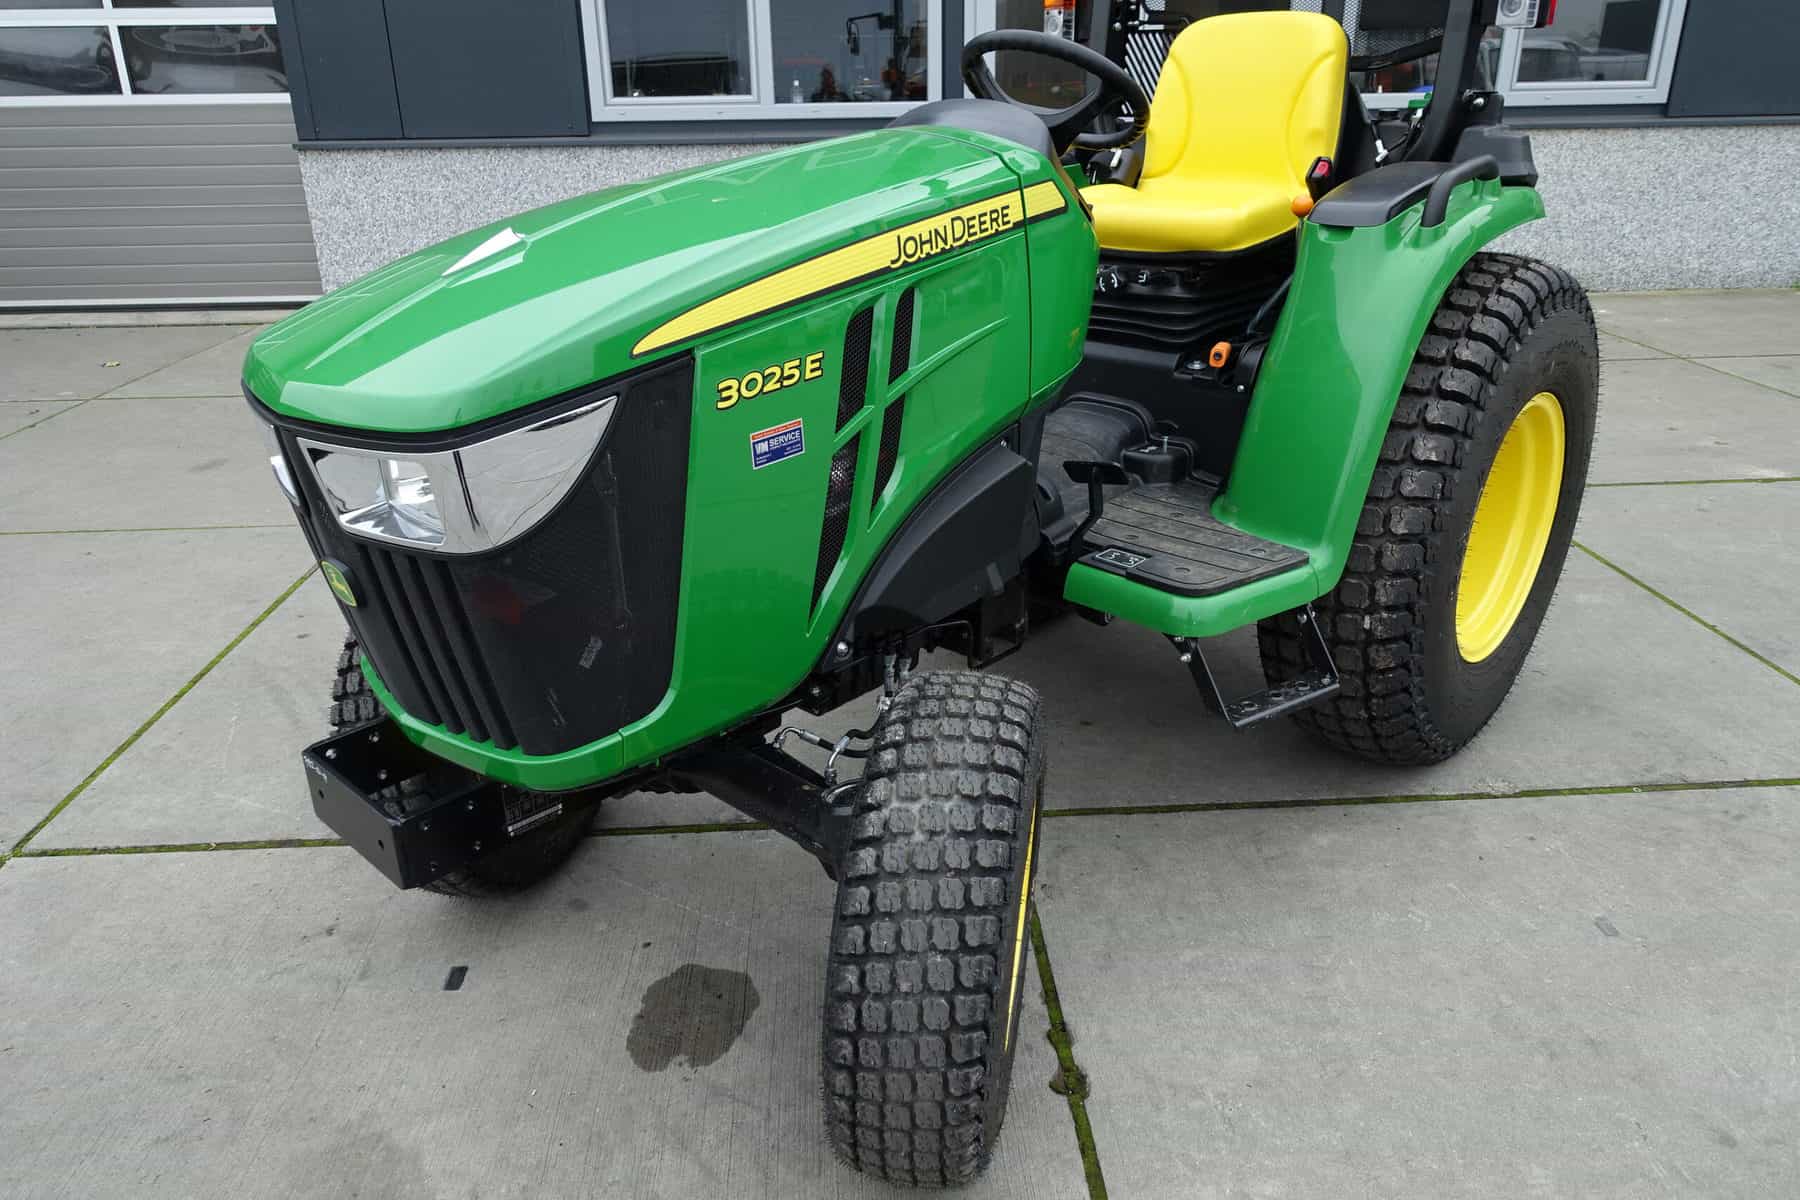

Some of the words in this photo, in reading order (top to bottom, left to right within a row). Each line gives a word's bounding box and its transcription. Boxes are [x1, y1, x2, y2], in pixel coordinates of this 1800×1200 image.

[891, 225, 948, 265] JOHN
[950, 204, 1012, 244] DEERE
[769, 430, 801, 447] SERVICE
